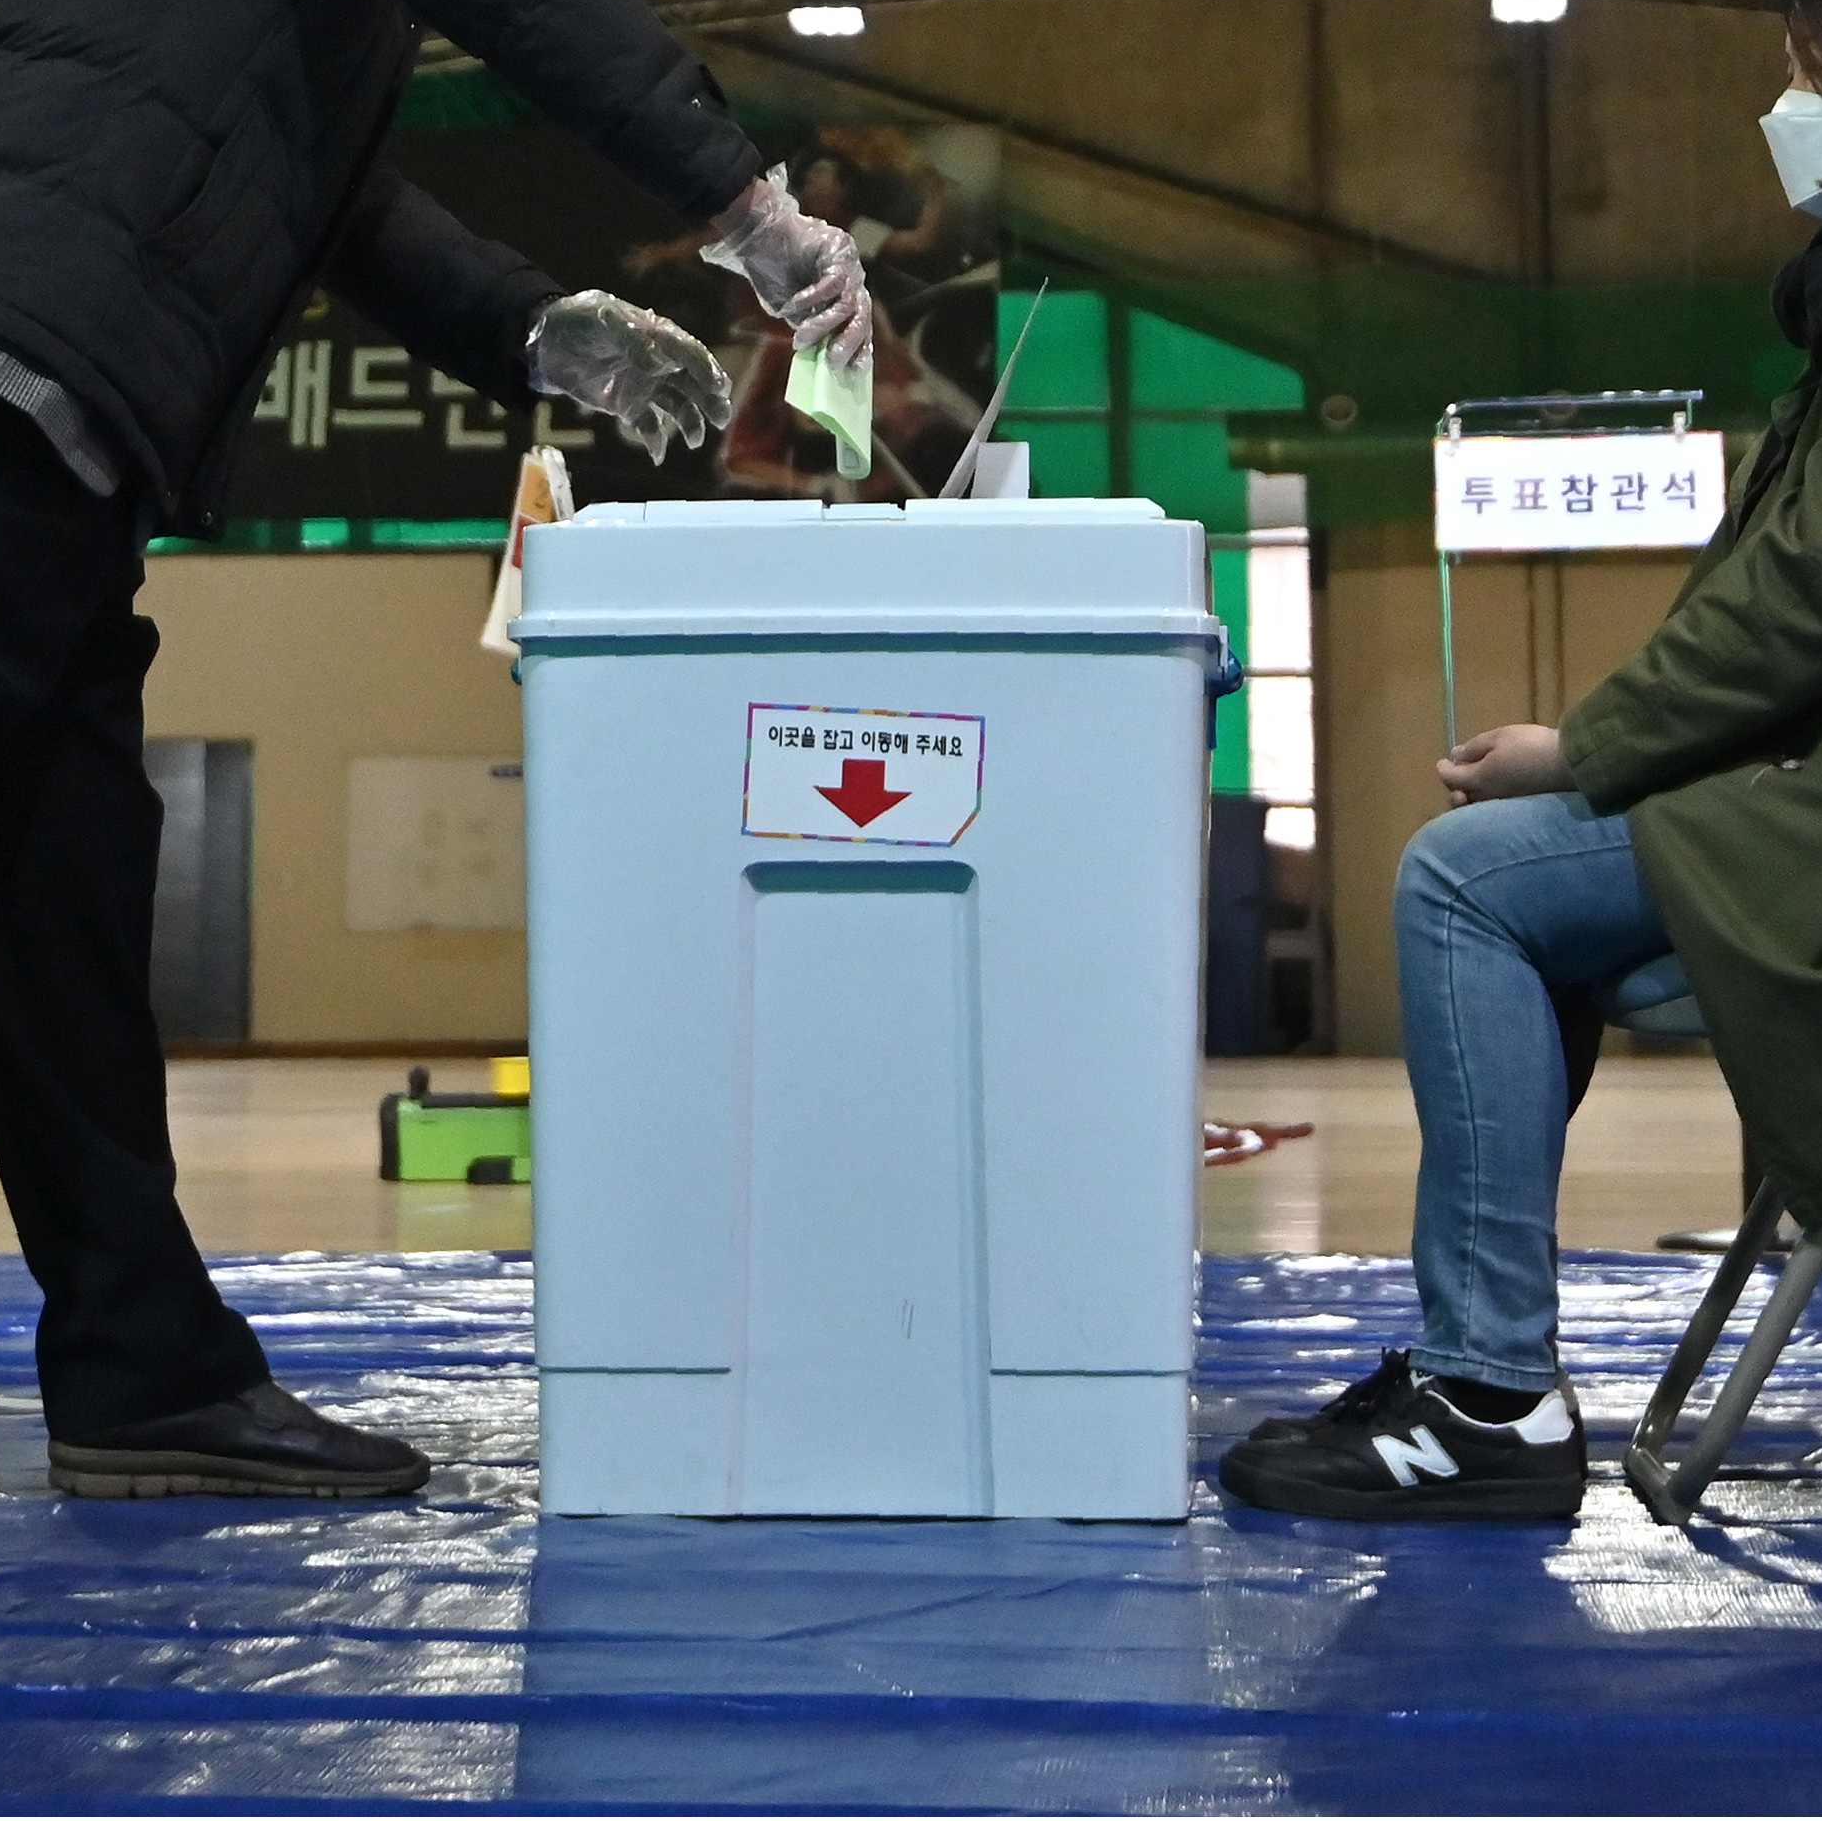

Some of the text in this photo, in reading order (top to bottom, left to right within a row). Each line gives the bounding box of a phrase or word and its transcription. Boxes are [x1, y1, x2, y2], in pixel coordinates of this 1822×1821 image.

[768, 726, 963, 757] 이곳을 잡고 이동해 주세요
